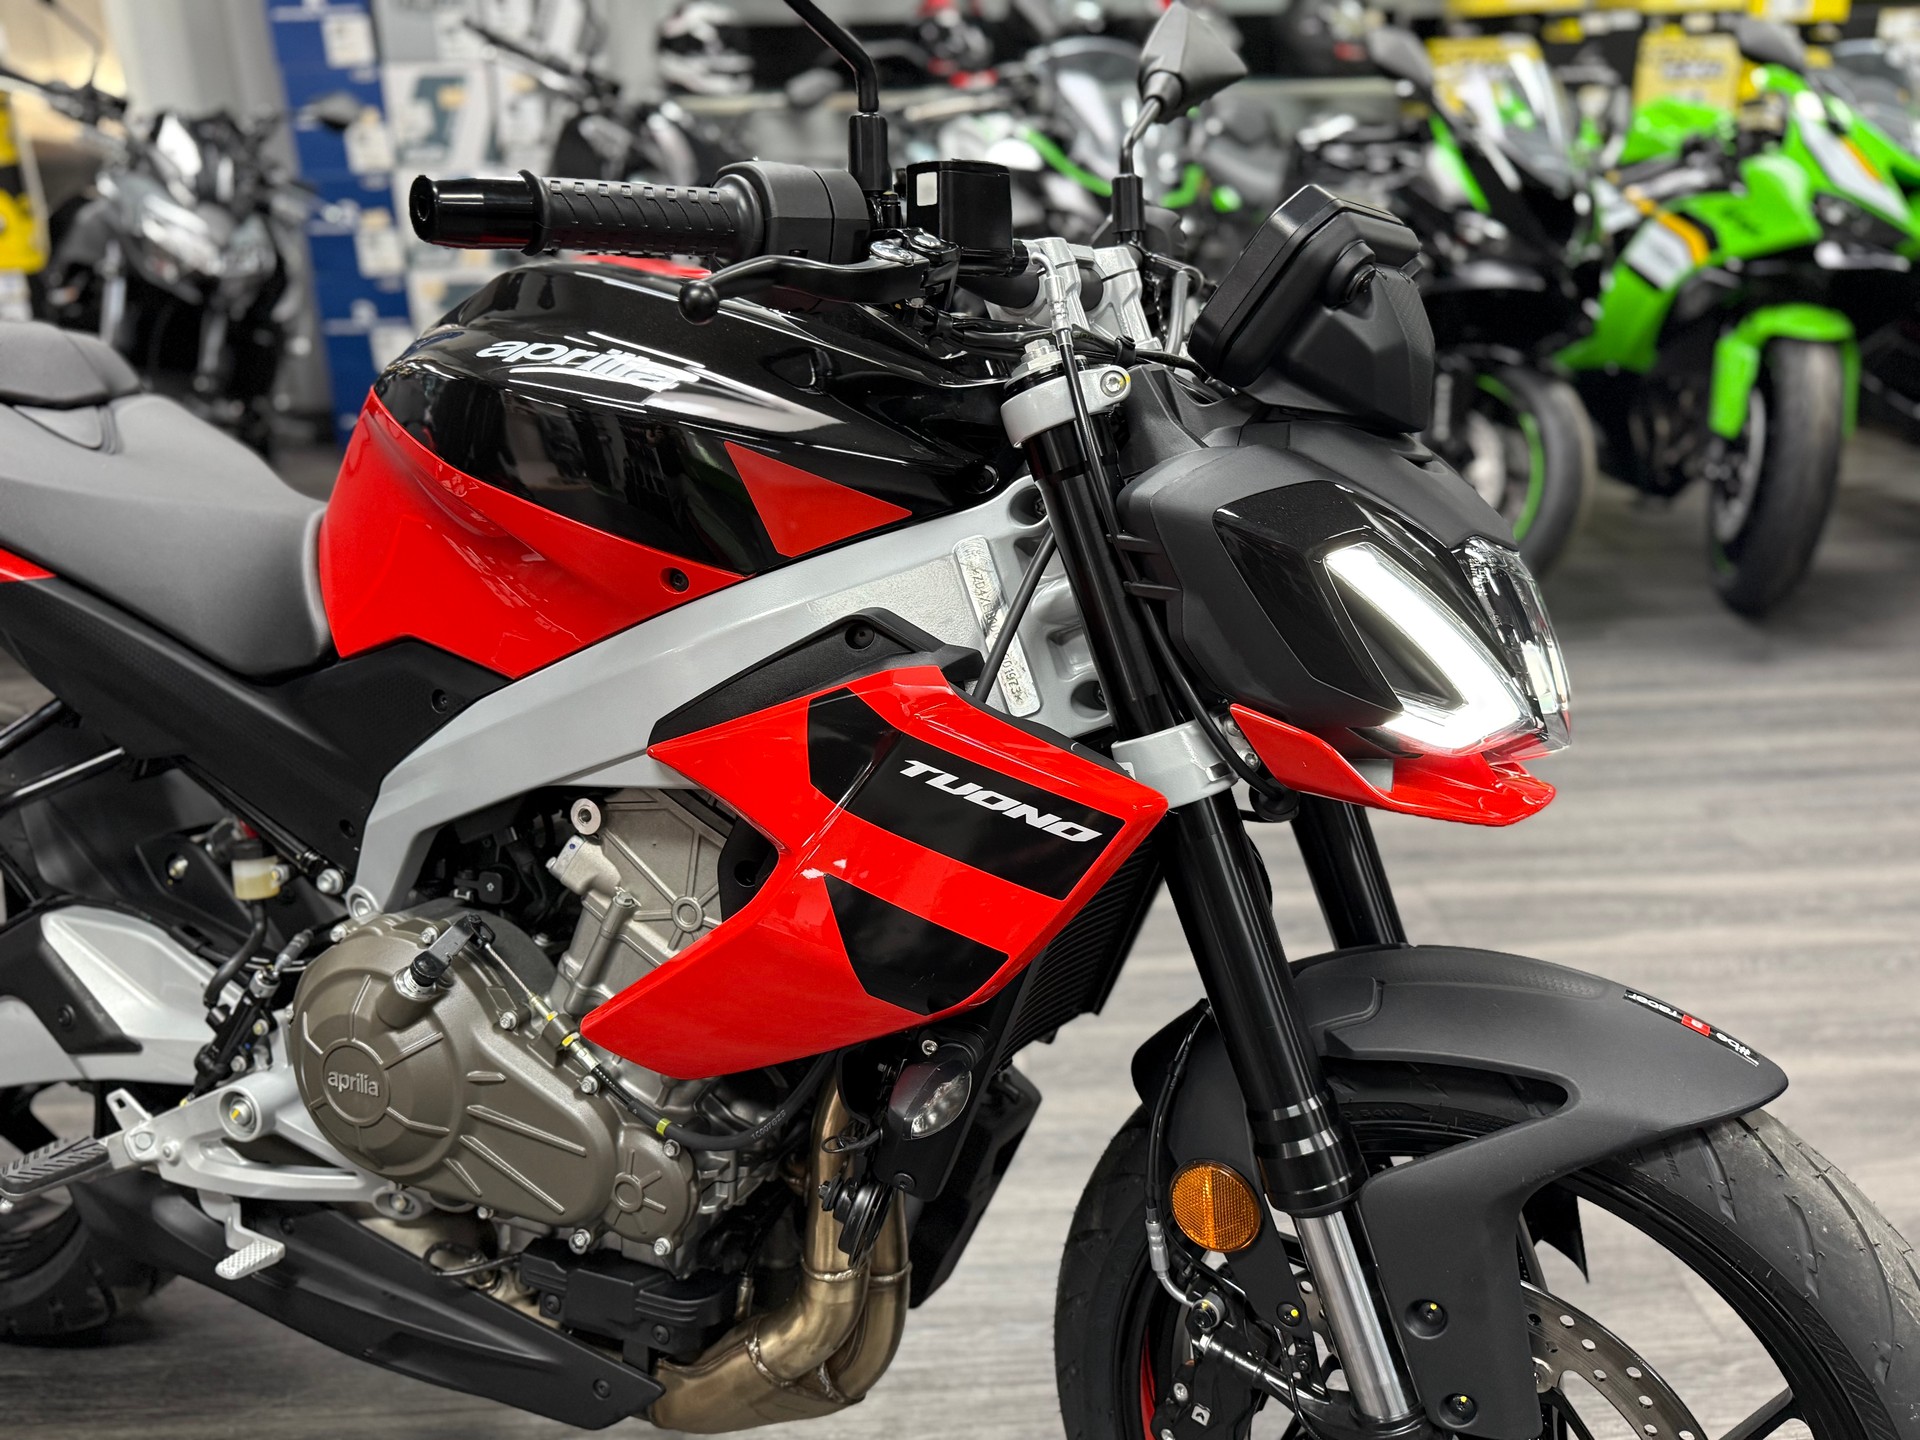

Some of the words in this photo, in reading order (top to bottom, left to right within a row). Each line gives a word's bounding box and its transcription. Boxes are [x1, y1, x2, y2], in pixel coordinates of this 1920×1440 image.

[476, 340, 681, 390] aprilia
[899, 760, 1103, 842] TUONO
[1628, 993, 1679, 1017] racer
[328, 1071, 380, 1097] aprilia
